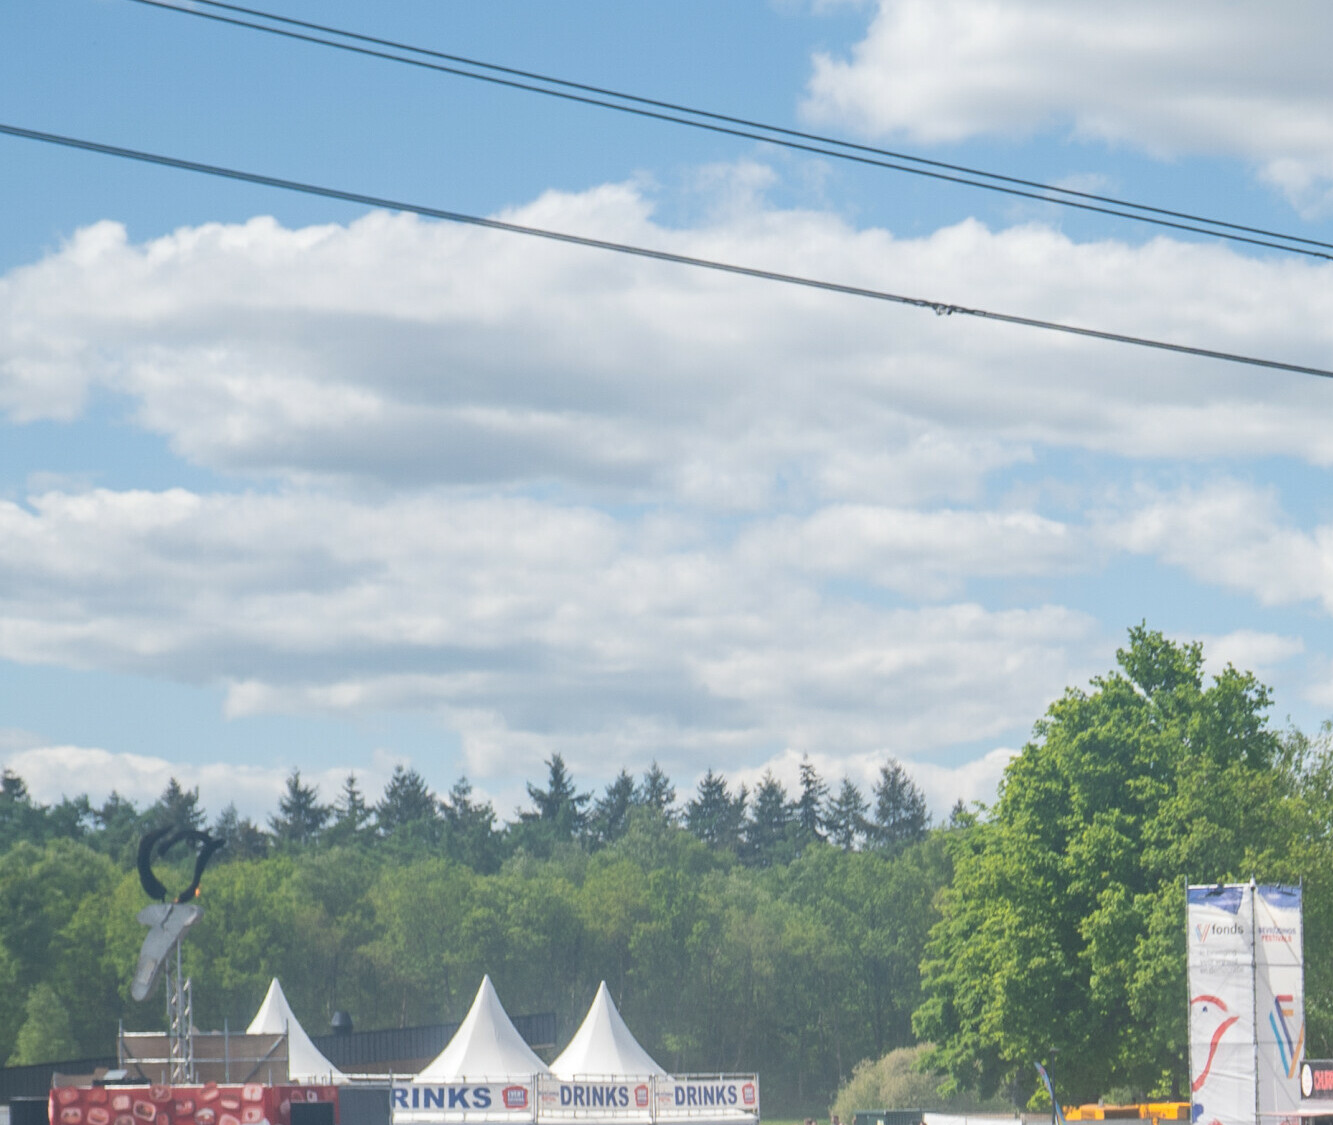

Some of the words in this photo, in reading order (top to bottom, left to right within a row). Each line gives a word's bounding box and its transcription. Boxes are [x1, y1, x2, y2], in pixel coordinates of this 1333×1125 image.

[392, 1087, 492, 1109] RINKS
[560, 1085, 629, 1107] DRINKS
[674, 1085, 738, 1106] DRINKS
